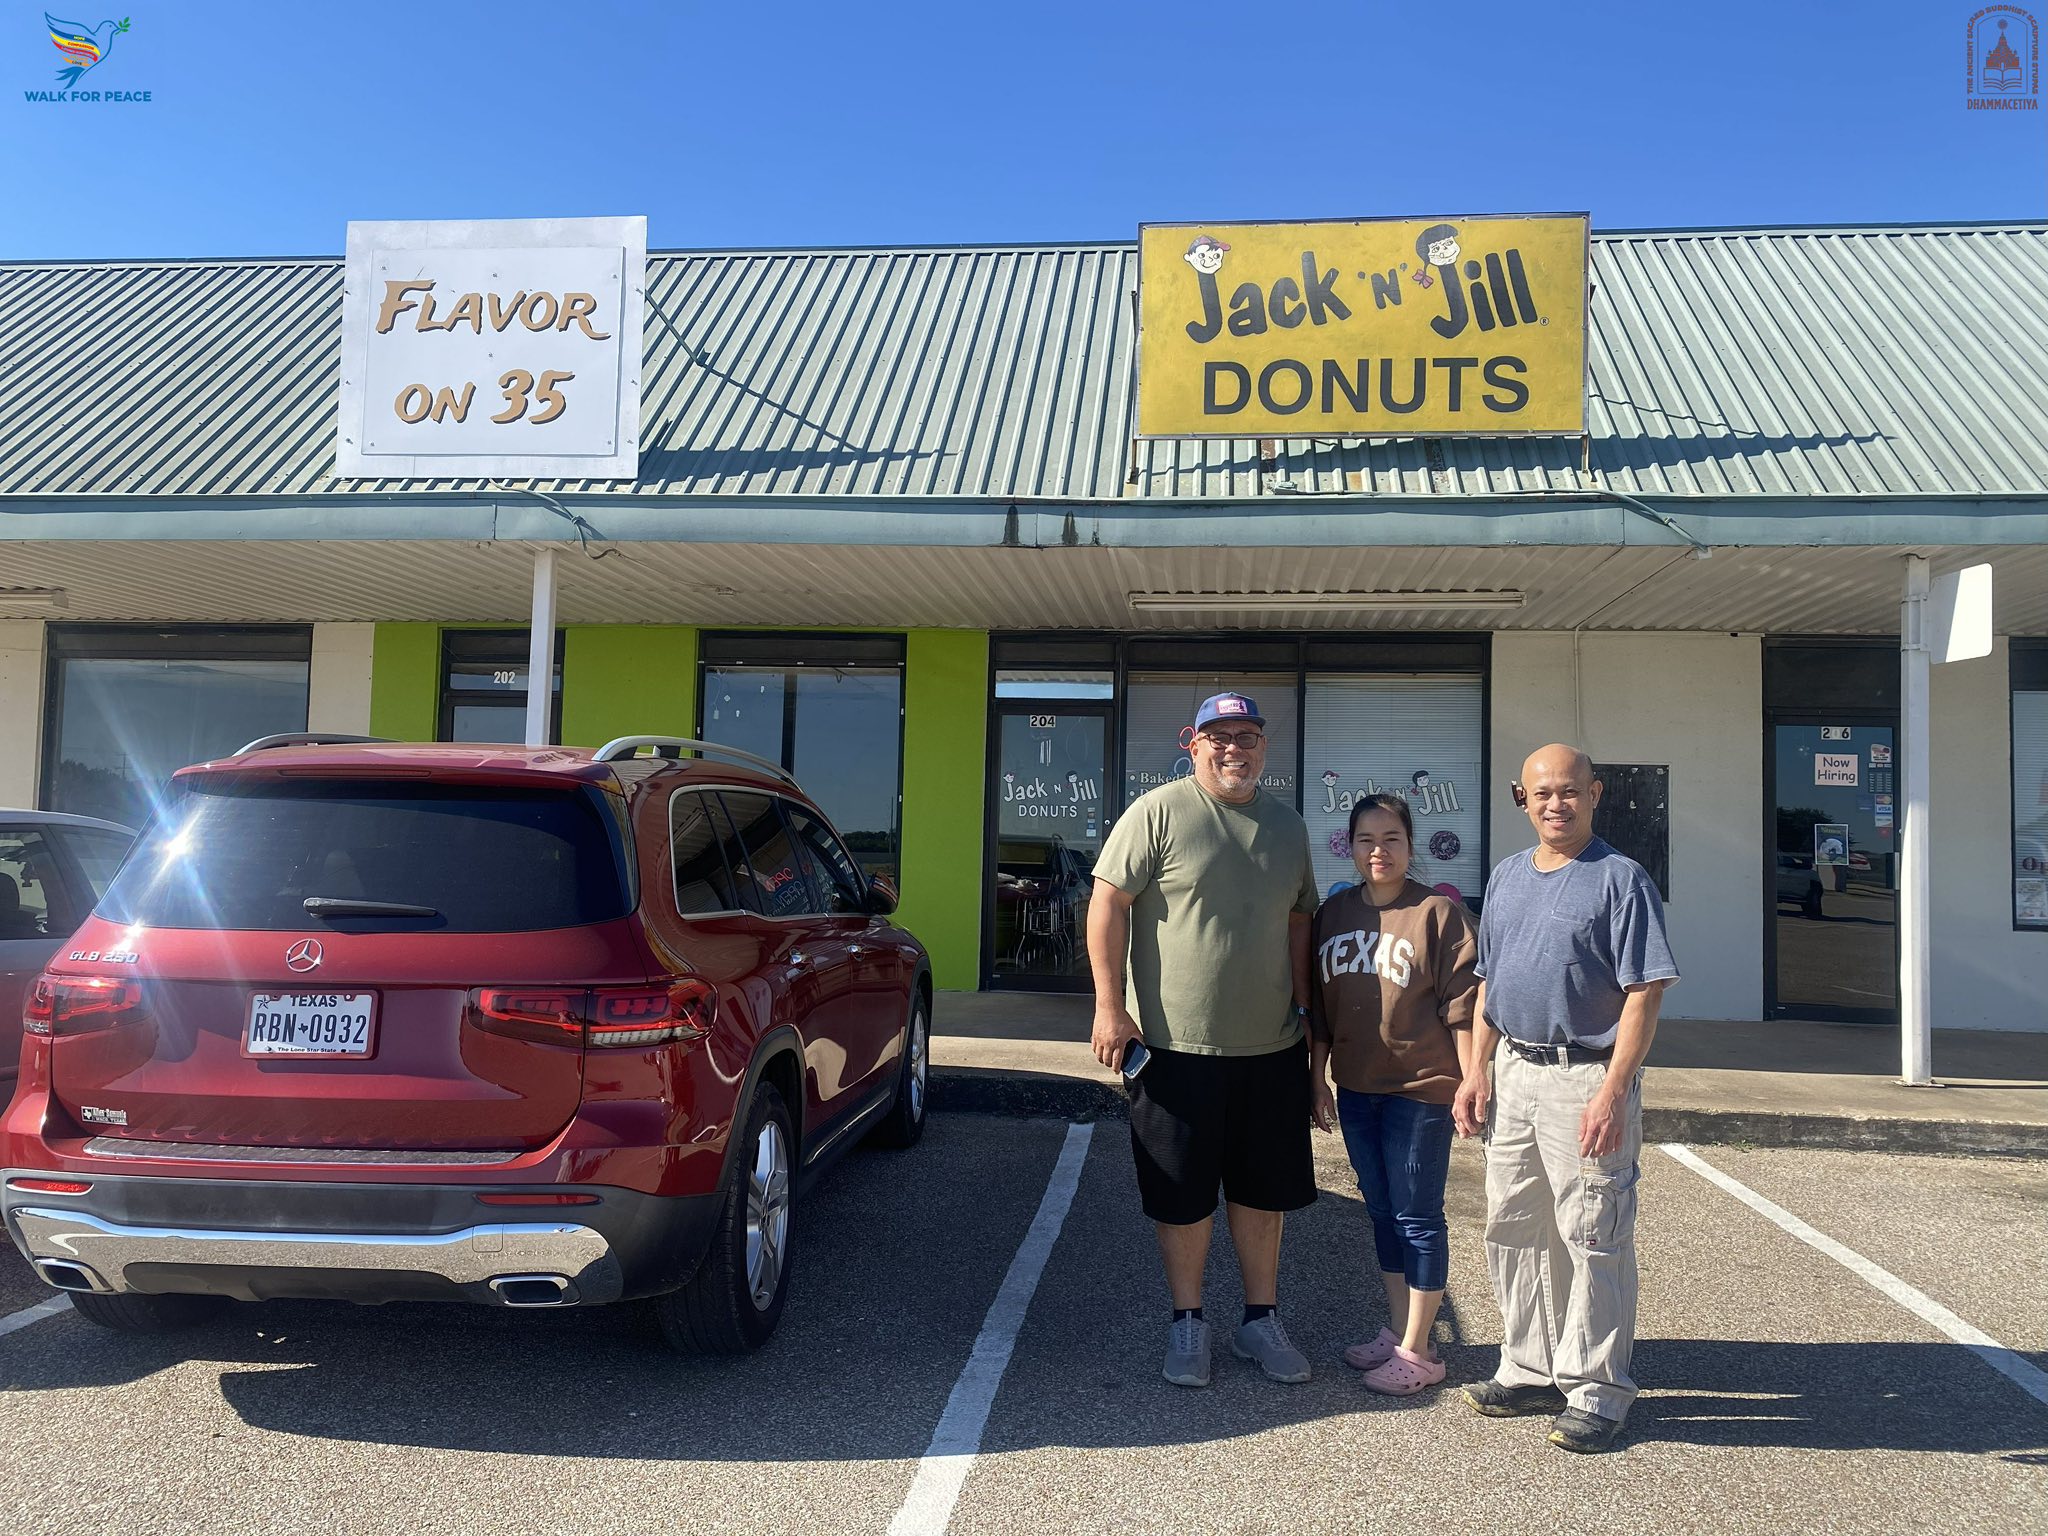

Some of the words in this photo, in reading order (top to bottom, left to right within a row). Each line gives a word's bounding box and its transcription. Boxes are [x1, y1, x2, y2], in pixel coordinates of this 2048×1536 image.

[1185, 250, 1352, 344] Jack
[1430, 248, 1538, 340] Jill
[375, 279, 612, 341] FLAVOR
[394, 381, 477, 424] ON
[489, 368, 576, 424] 35
[1203, 355, 1530, 416] DONUTS
[493, 671, 516, 684] 202
[1030, 716, 1056, 727] 204
[1822, 756, 1850, 768] Now
[1817, 769, 1856, 784] Hiring
[1003, 777, 1048, 802] Jack
[1069, 778, 1098, 803] Jill
[1418, 780, 1459, 816] Jill
[1018, 804, 1078, 818] DONUTS
[69, 950, 100, 961] GLB
[1318, 929, 1415, 989] TEXAS
[290, 995, 338, 1007] TEXAS
[252, 1012, 297, 1042] RBN
[308, 1013, 367, 1044] 0932
